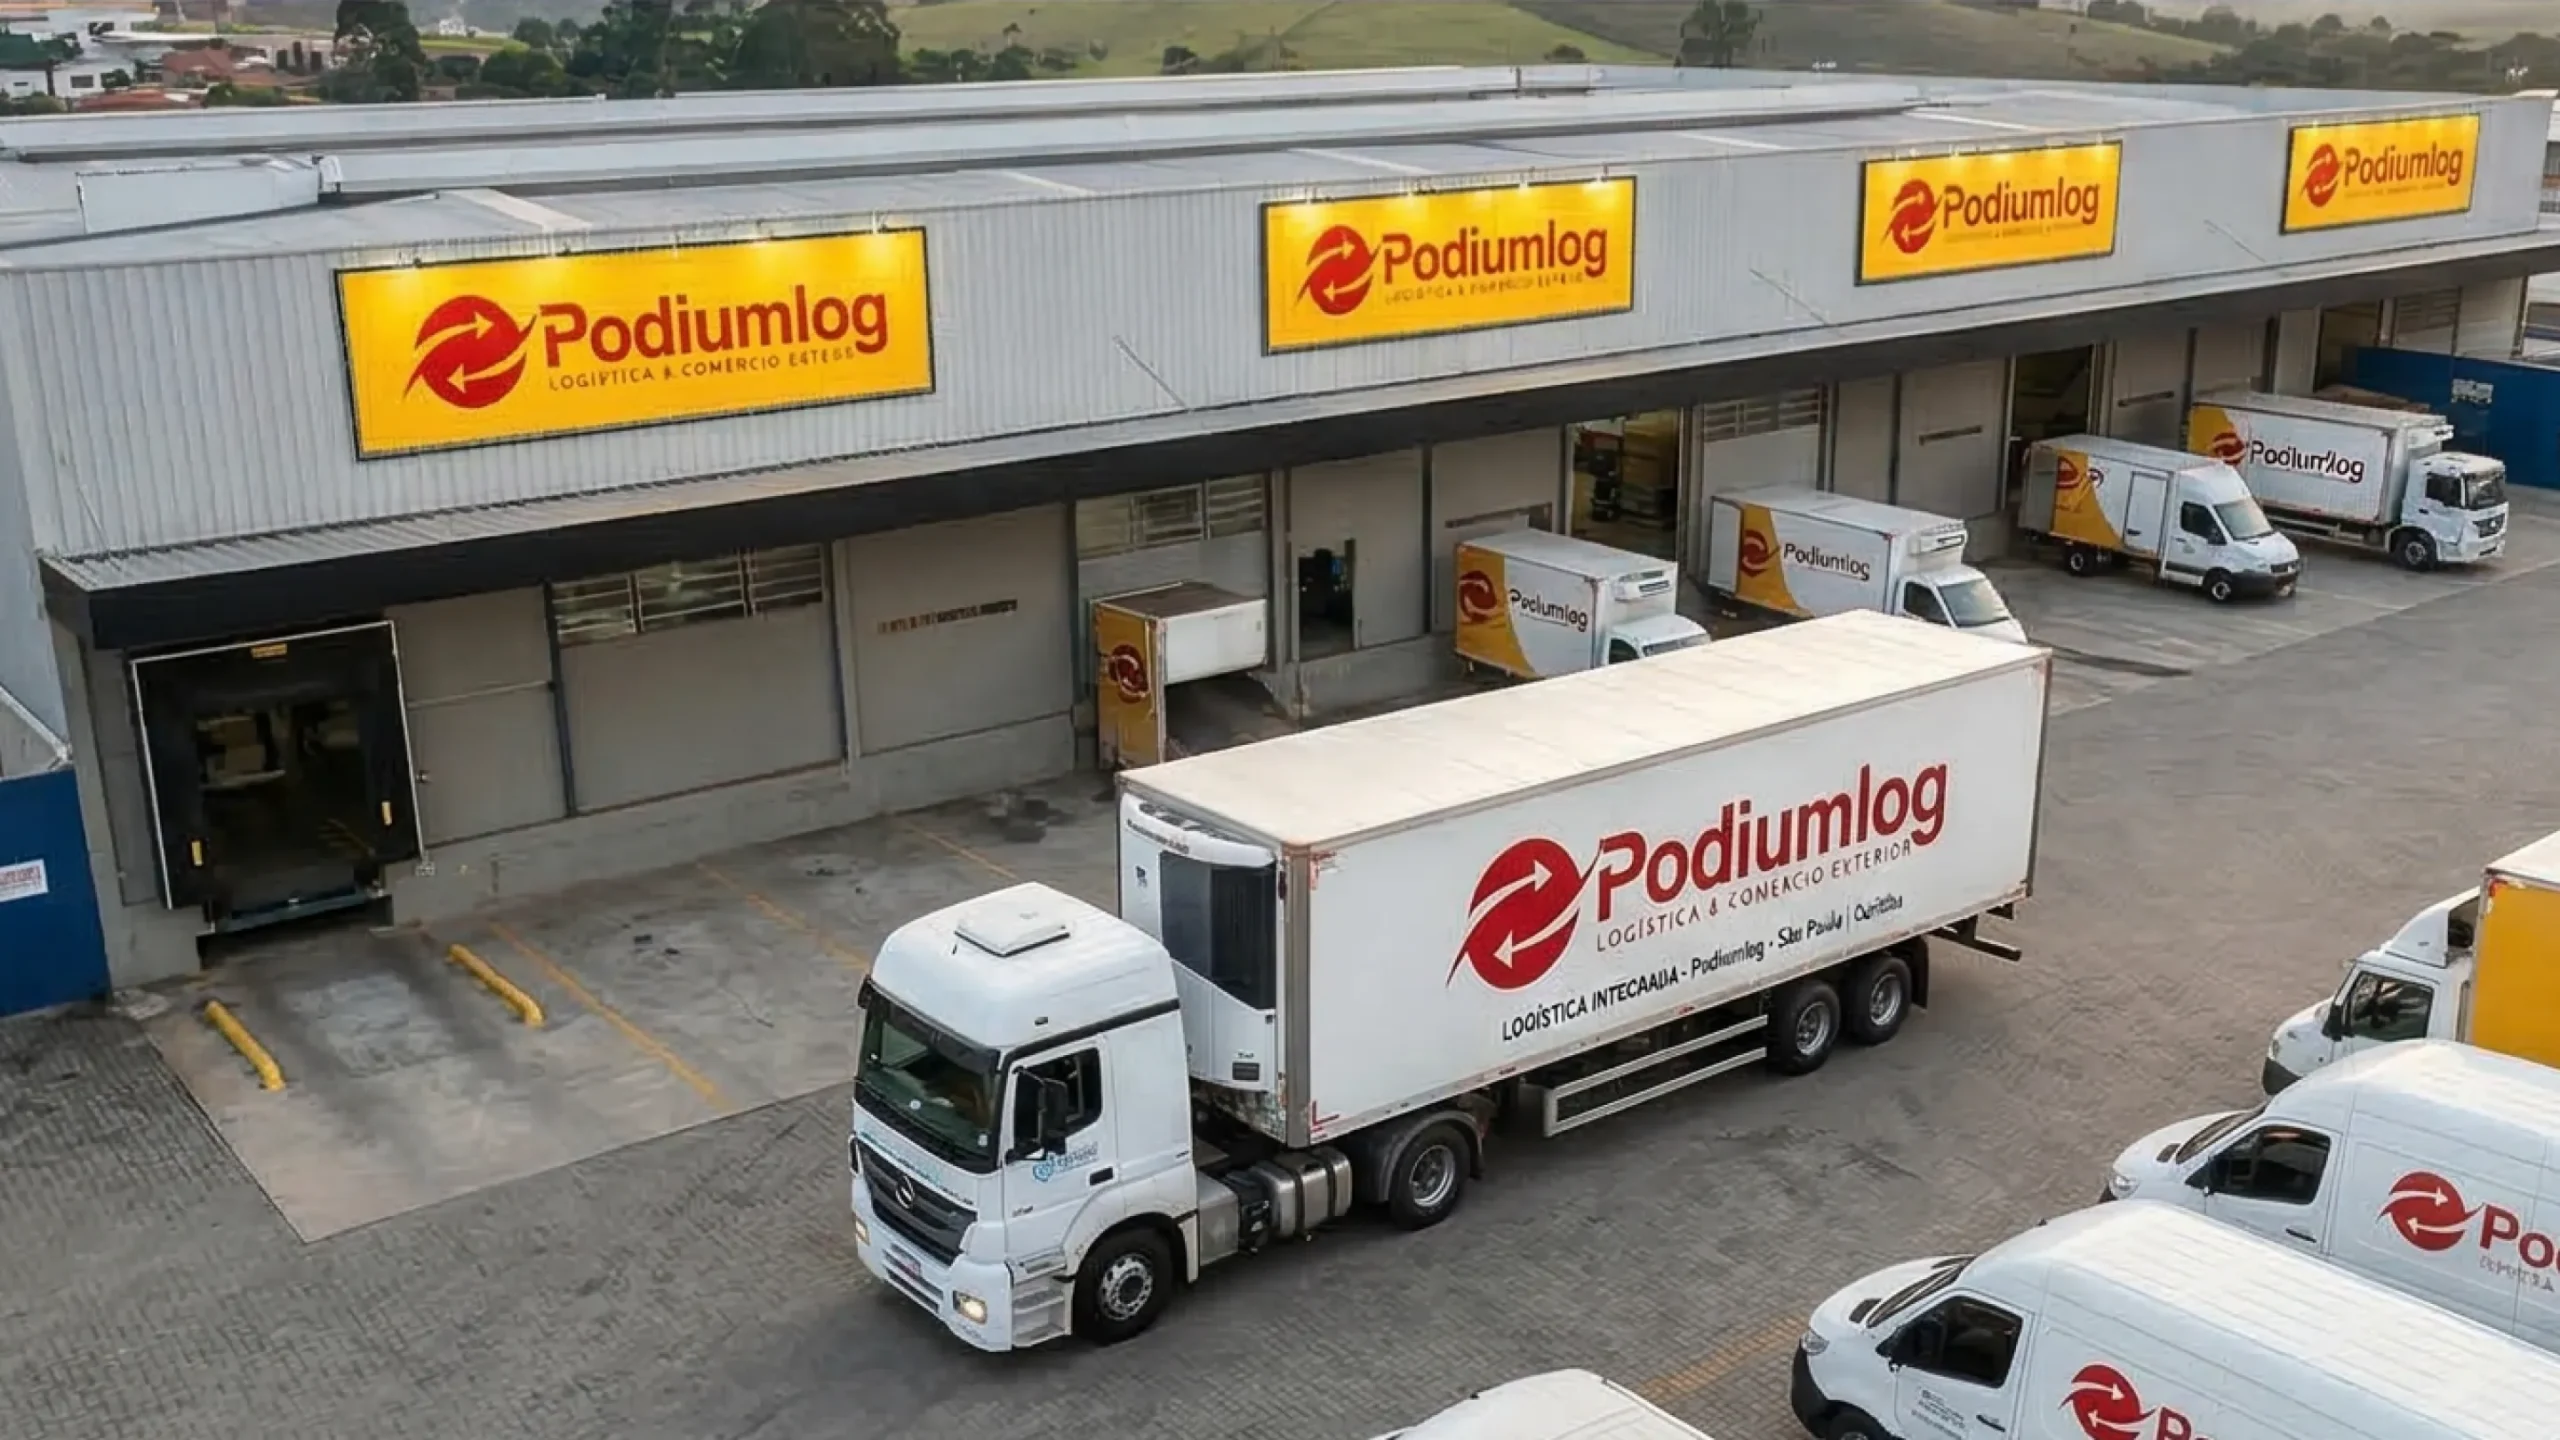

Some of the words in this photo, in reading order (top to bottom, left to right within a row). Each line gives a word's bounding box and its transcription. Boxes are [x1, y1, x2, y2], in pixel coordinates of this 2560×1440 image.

[2344, 141, 2463, 186] Podiumlog
[1943, 177, 2099, 228] Podiumlog
[1382, 219, 1607, 284] Podiumlog
[540, 285, 887, 367] Podiumlog
[1597, 764, 1948, 921] Podiumlog
[2480, 1204, 2560, 1274] Po
